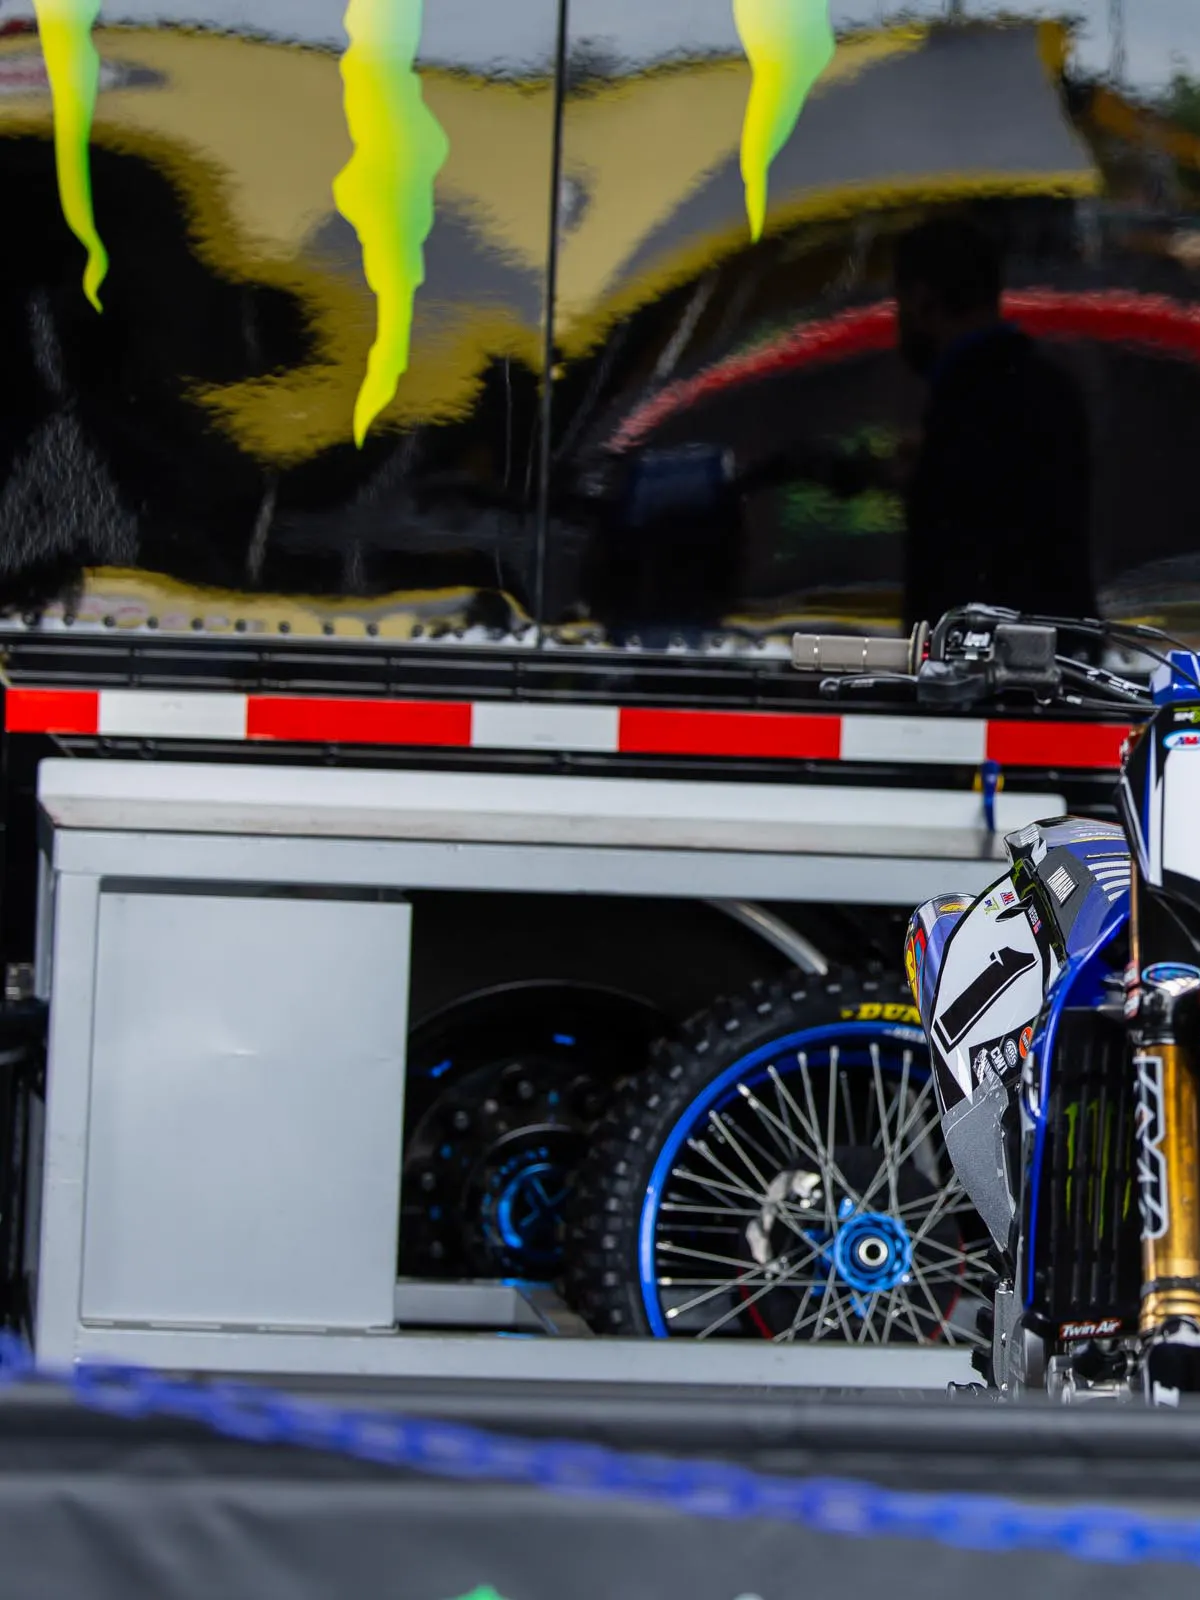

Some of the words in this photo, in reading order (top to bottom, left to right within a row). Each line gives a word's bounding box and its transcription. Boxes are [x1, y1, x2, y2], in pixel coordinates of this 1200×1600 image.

[933, 946, 1039, 1054] 1
[857, 1002, 922, 1025] DUN
[1062, 1323, 1096, 1337] Twin
[1096, 1320, 1120, 1333] Air
